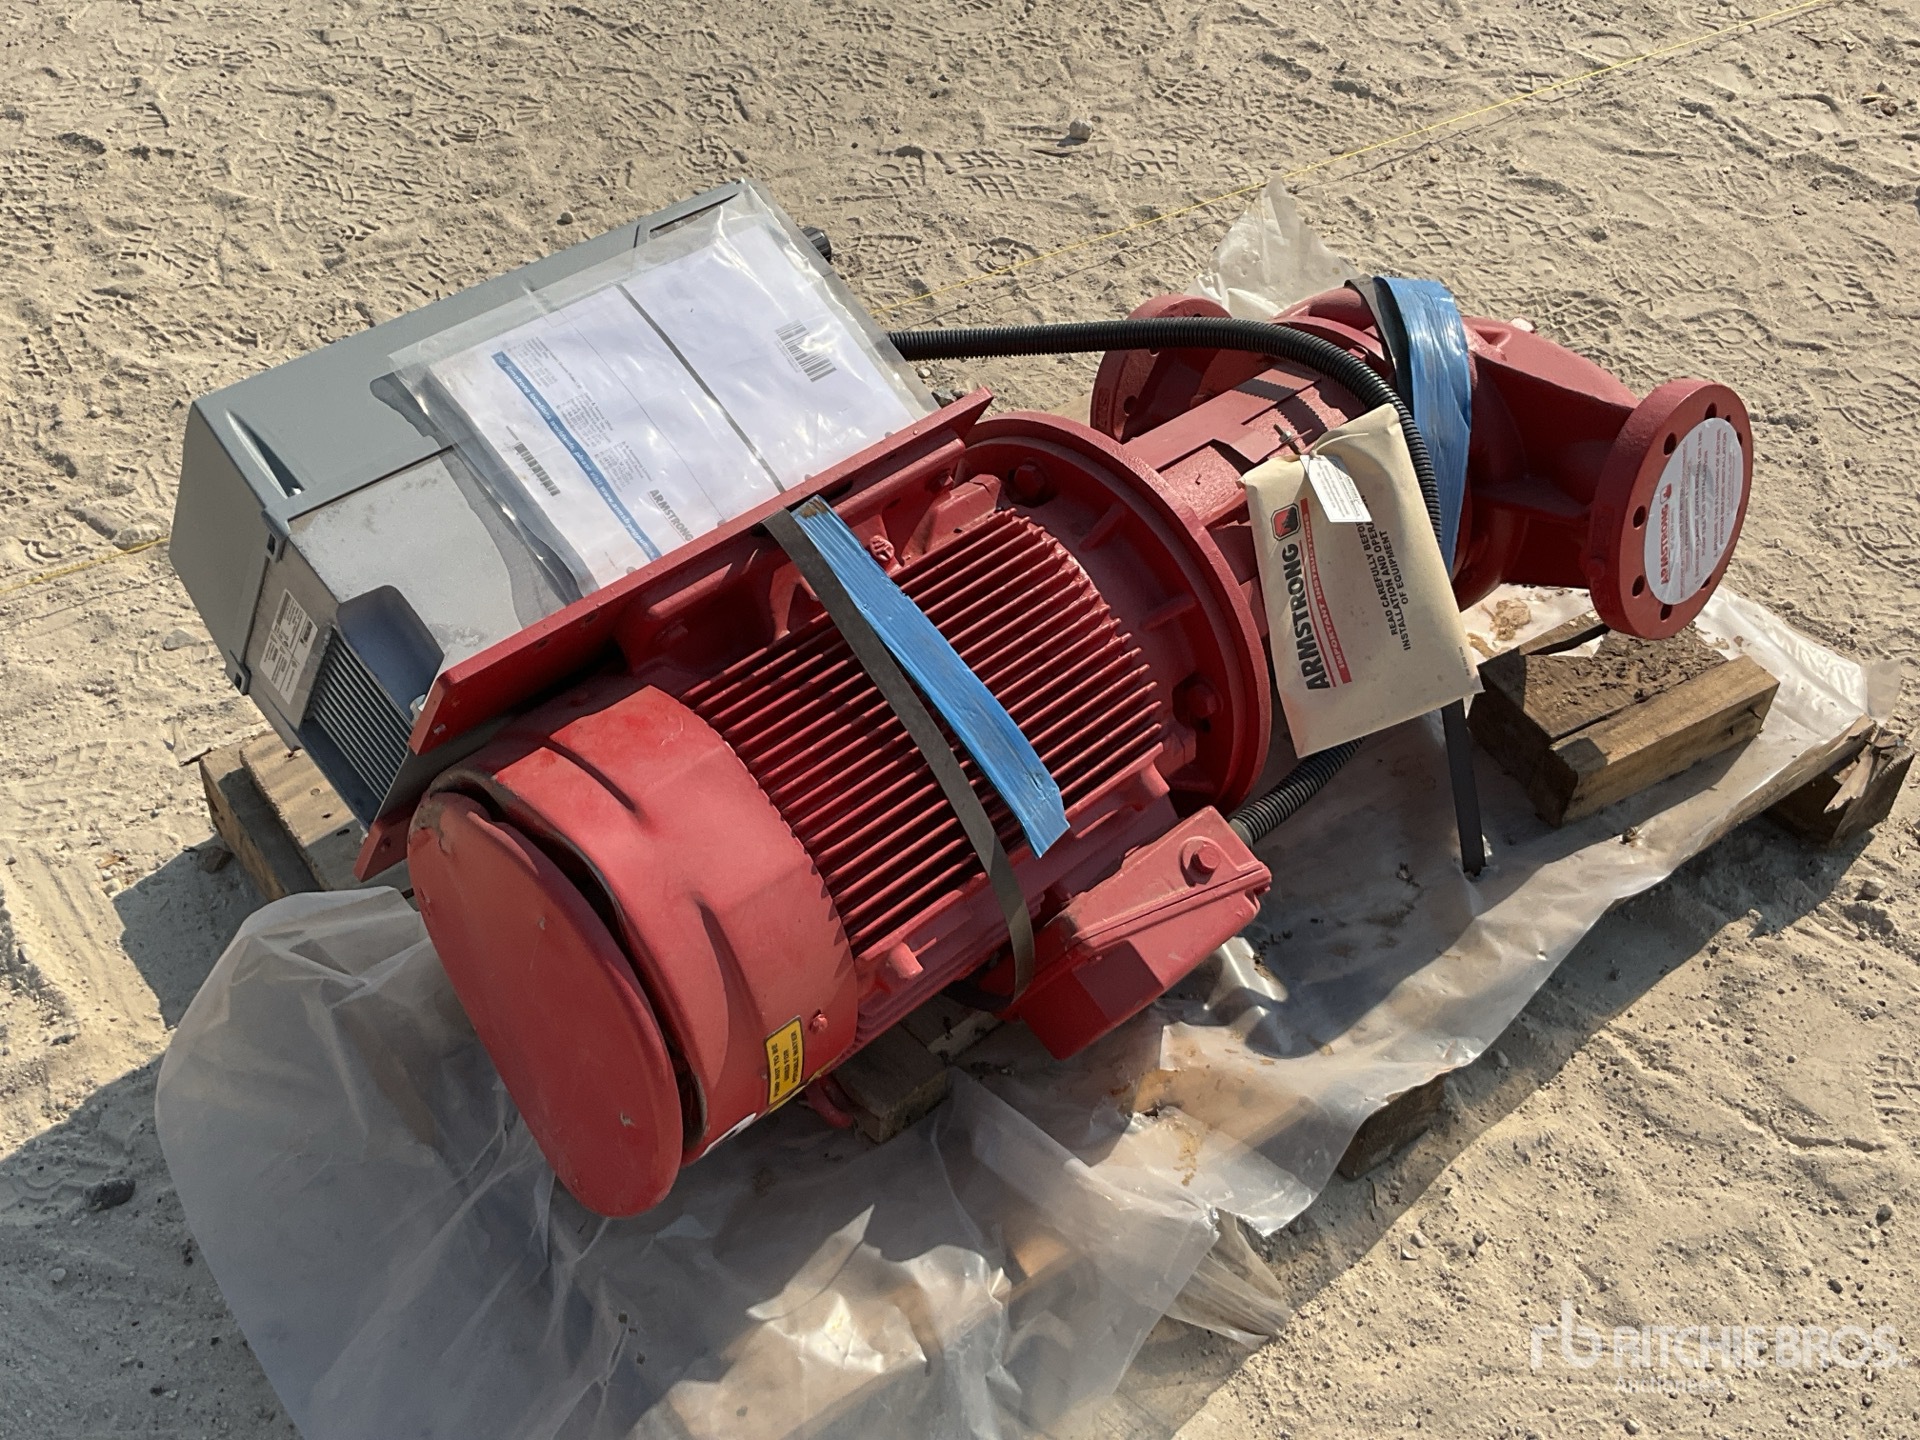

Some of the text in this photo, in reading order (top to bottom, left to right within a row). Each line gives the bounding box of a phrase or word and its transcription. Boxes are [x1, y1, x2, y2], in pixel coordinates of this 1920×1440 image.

[505, 365, 532, 394] Armstrong
[529, 392, 553, 420] locations
[573, 450, 592, 472] please
[590, 471, 604, 486] visit
[649, 489, 694, 542] ARMSTRONG
[1661, 504, 1670, 584] ARMSTRONG
[1303, 513, 1345, 669] IMPORTANT INSTRUCTIONS
[1366, 554, 1391, 608] CAREFULLY
[1376, 555, 1391, 577] AND
[1379, 529, 1409, 605] OF EQUIPMENT
[1282, 543, 1331, 690] ARMSTRONG
[1383, 579, 1411, 650] INSTALLATION
[1385, 610, 1398, 636] READ
[773, 1055, 780, 1066] TO
